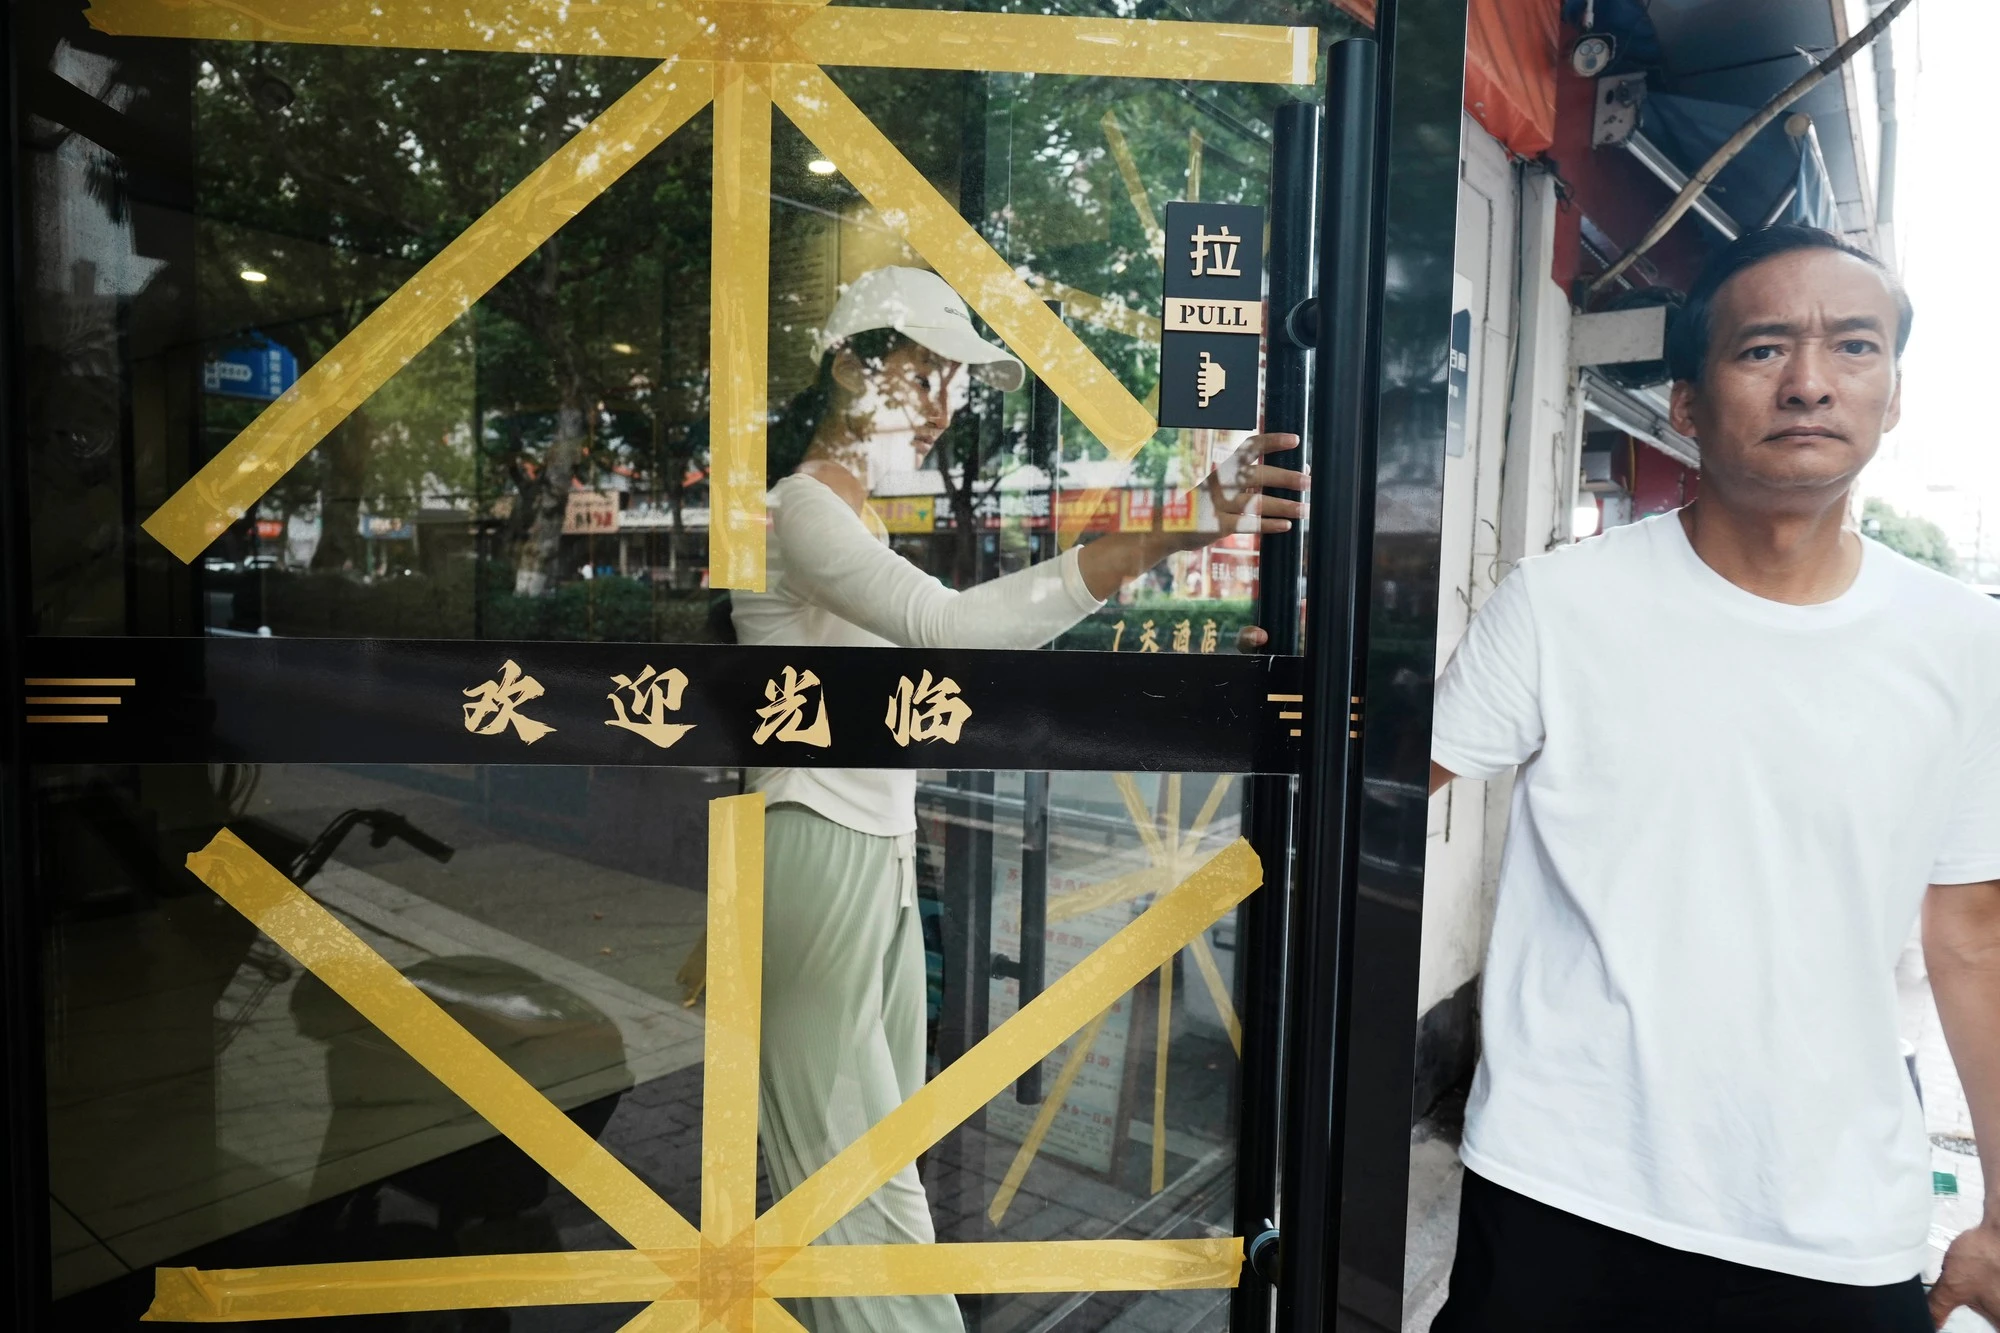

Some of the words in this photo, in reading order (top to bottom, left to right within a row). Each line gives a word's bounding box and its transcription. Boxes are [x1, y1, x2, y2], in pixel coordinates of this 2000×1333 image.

[1190, 224, 1241, 277] 拉
[1179, 304, 1248, 327] PULL
[462, 659, 973, 748] 欢迎光临
